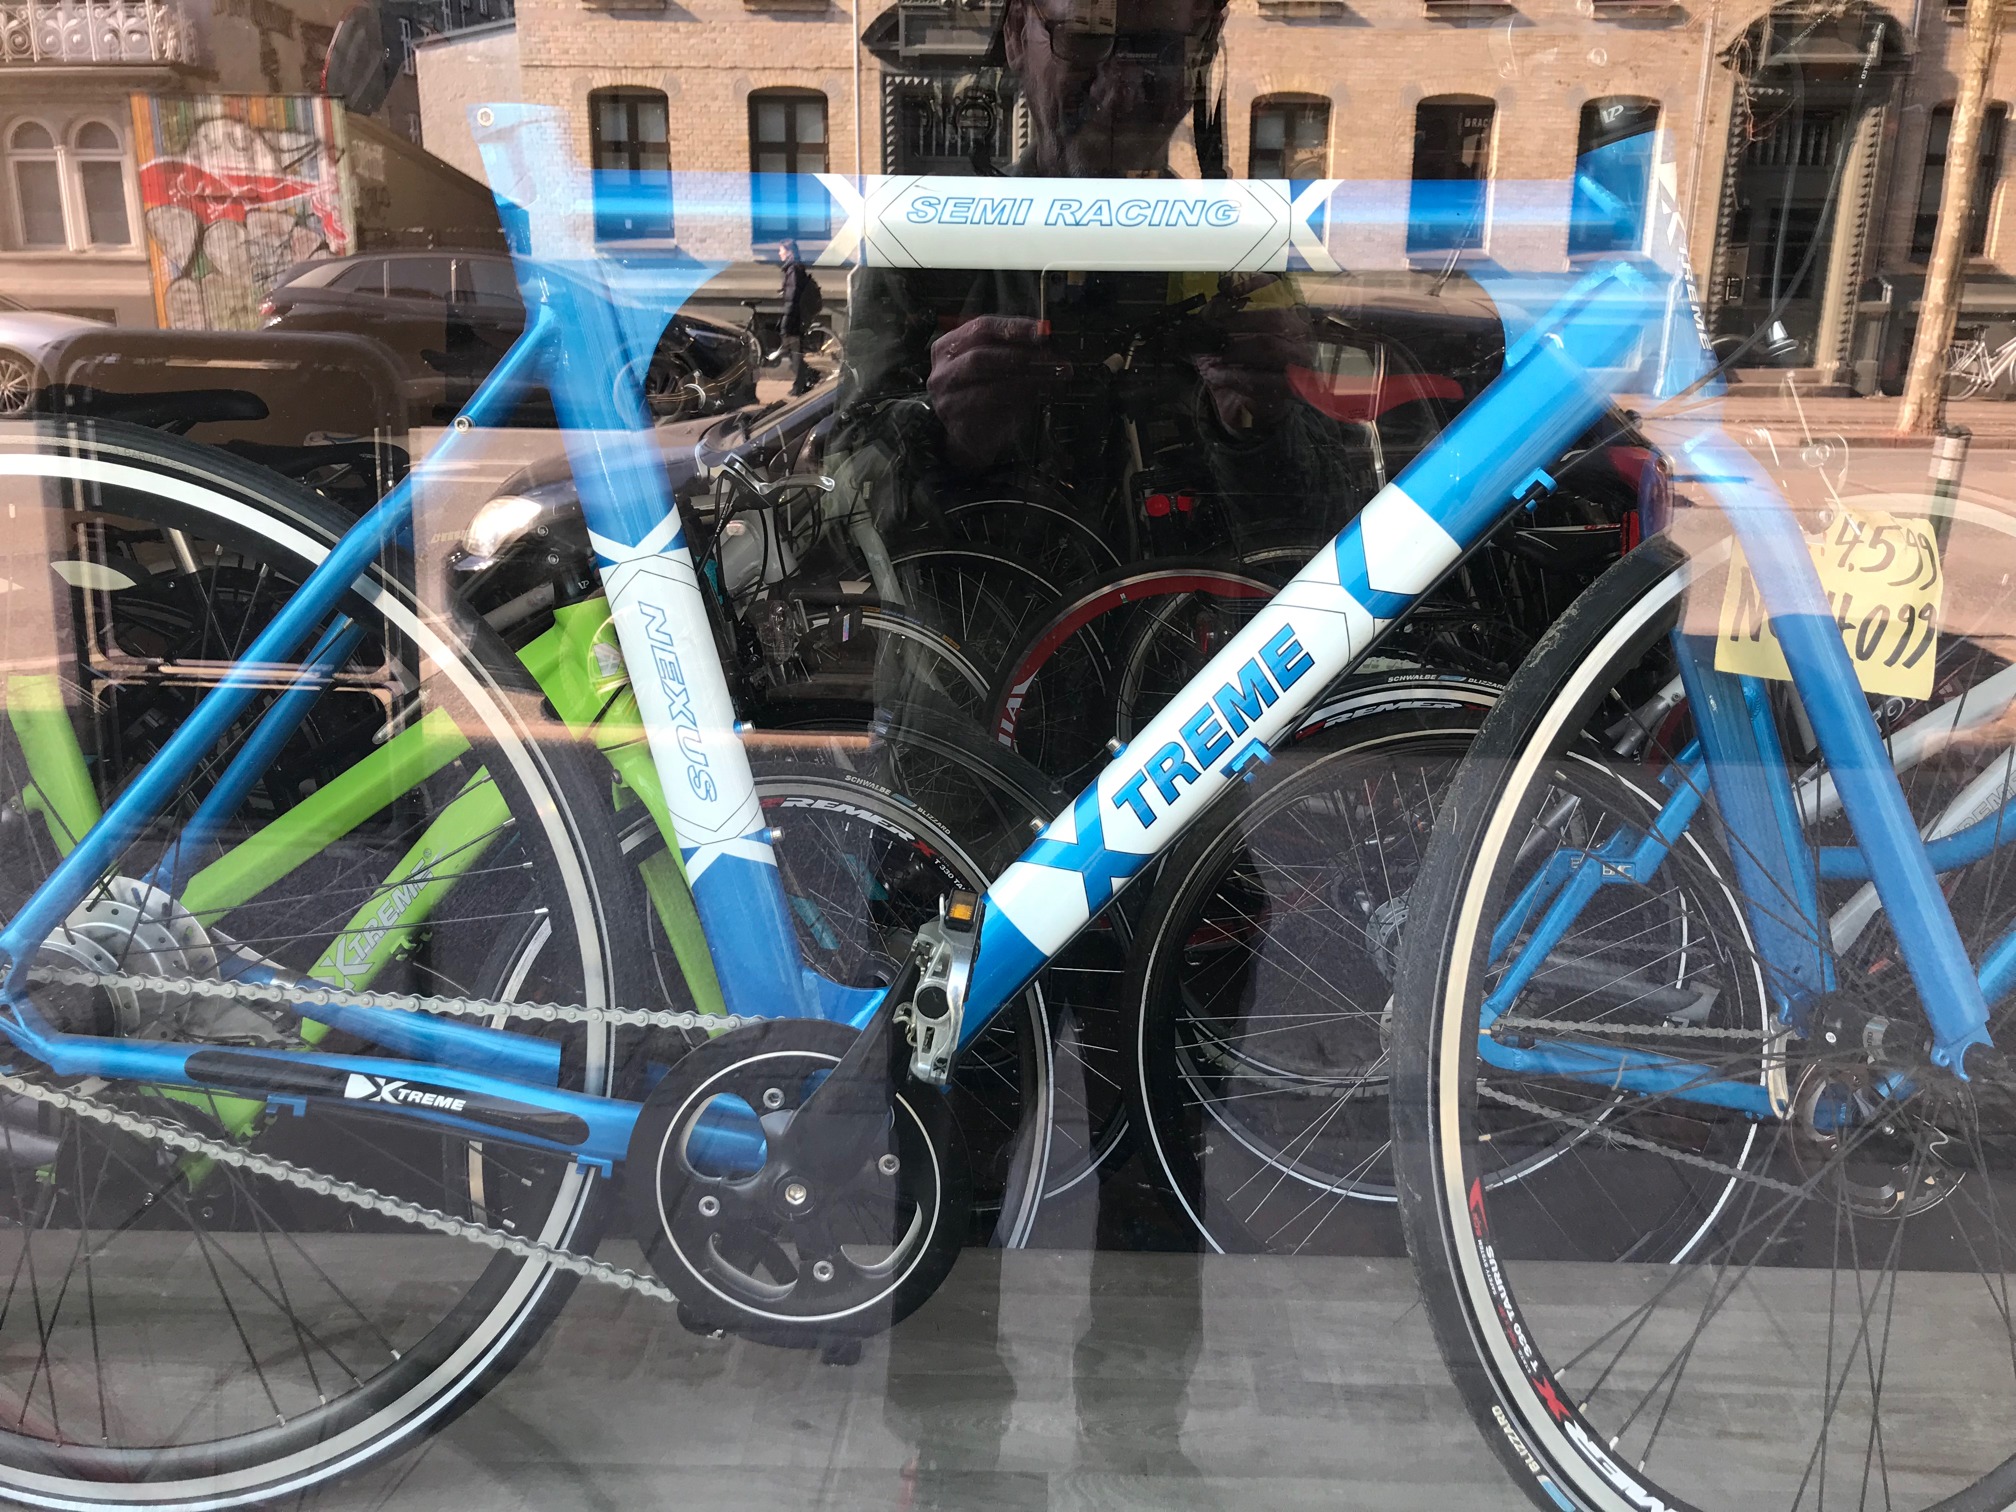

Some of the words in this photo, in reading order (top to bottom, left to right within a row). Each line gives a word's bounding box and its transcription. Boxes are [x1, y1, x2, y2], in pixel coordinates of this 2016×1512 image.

[906, 196, 1013, 226] SEMI
[1044, 198, 1242, 228] RACING
[1730, 566, 1781, 643] N
[638, 600, 717, 802] NEXUS
[1387, 674, 1438, 683] SCHWALBE
[1467, 677, 1506, 690] BLIZZAR
[844, 774, 892, 796] SCHWALBE
[917, 806, 951, 835] BLIZZARD
[939, 863, 955, 880] 330
[368, 1076, 467, 1111] XTREME
[1485, 1244, 1516, 1322] TAURUS
[1513, 1322, 1534, 1358] 330
[1491, 1404, 1541, 1475] BLIZZARD
